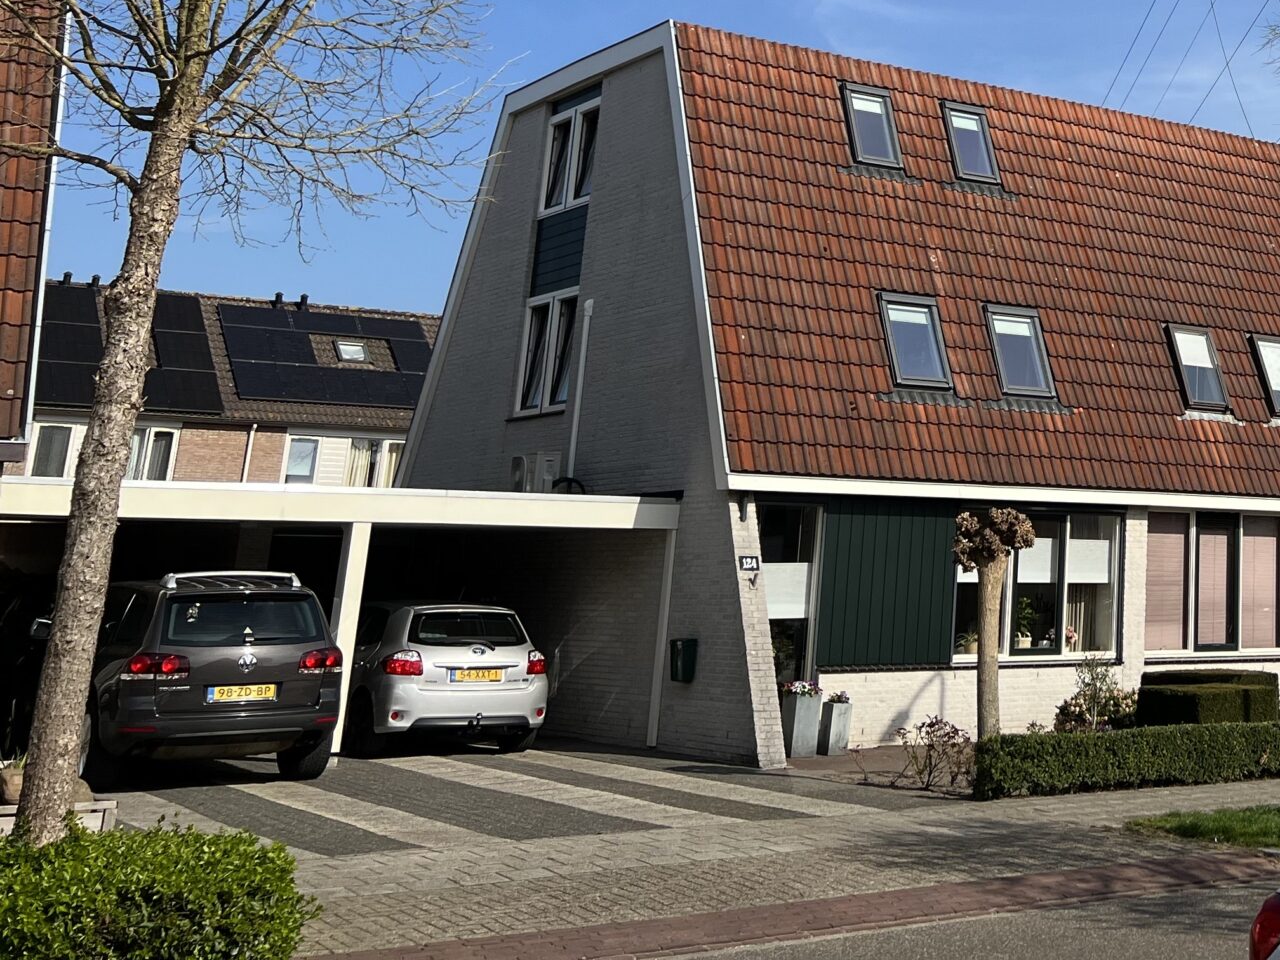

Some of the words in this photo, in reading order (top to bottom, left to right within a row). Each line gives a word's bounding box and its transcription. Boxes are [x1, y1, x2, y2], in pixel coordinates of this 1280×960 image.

[742, 557, 757, 569] 124
[460, 670, 498, 680] 54-XXT-1
[218, 686, 271, 698] 98-ZD-BP
